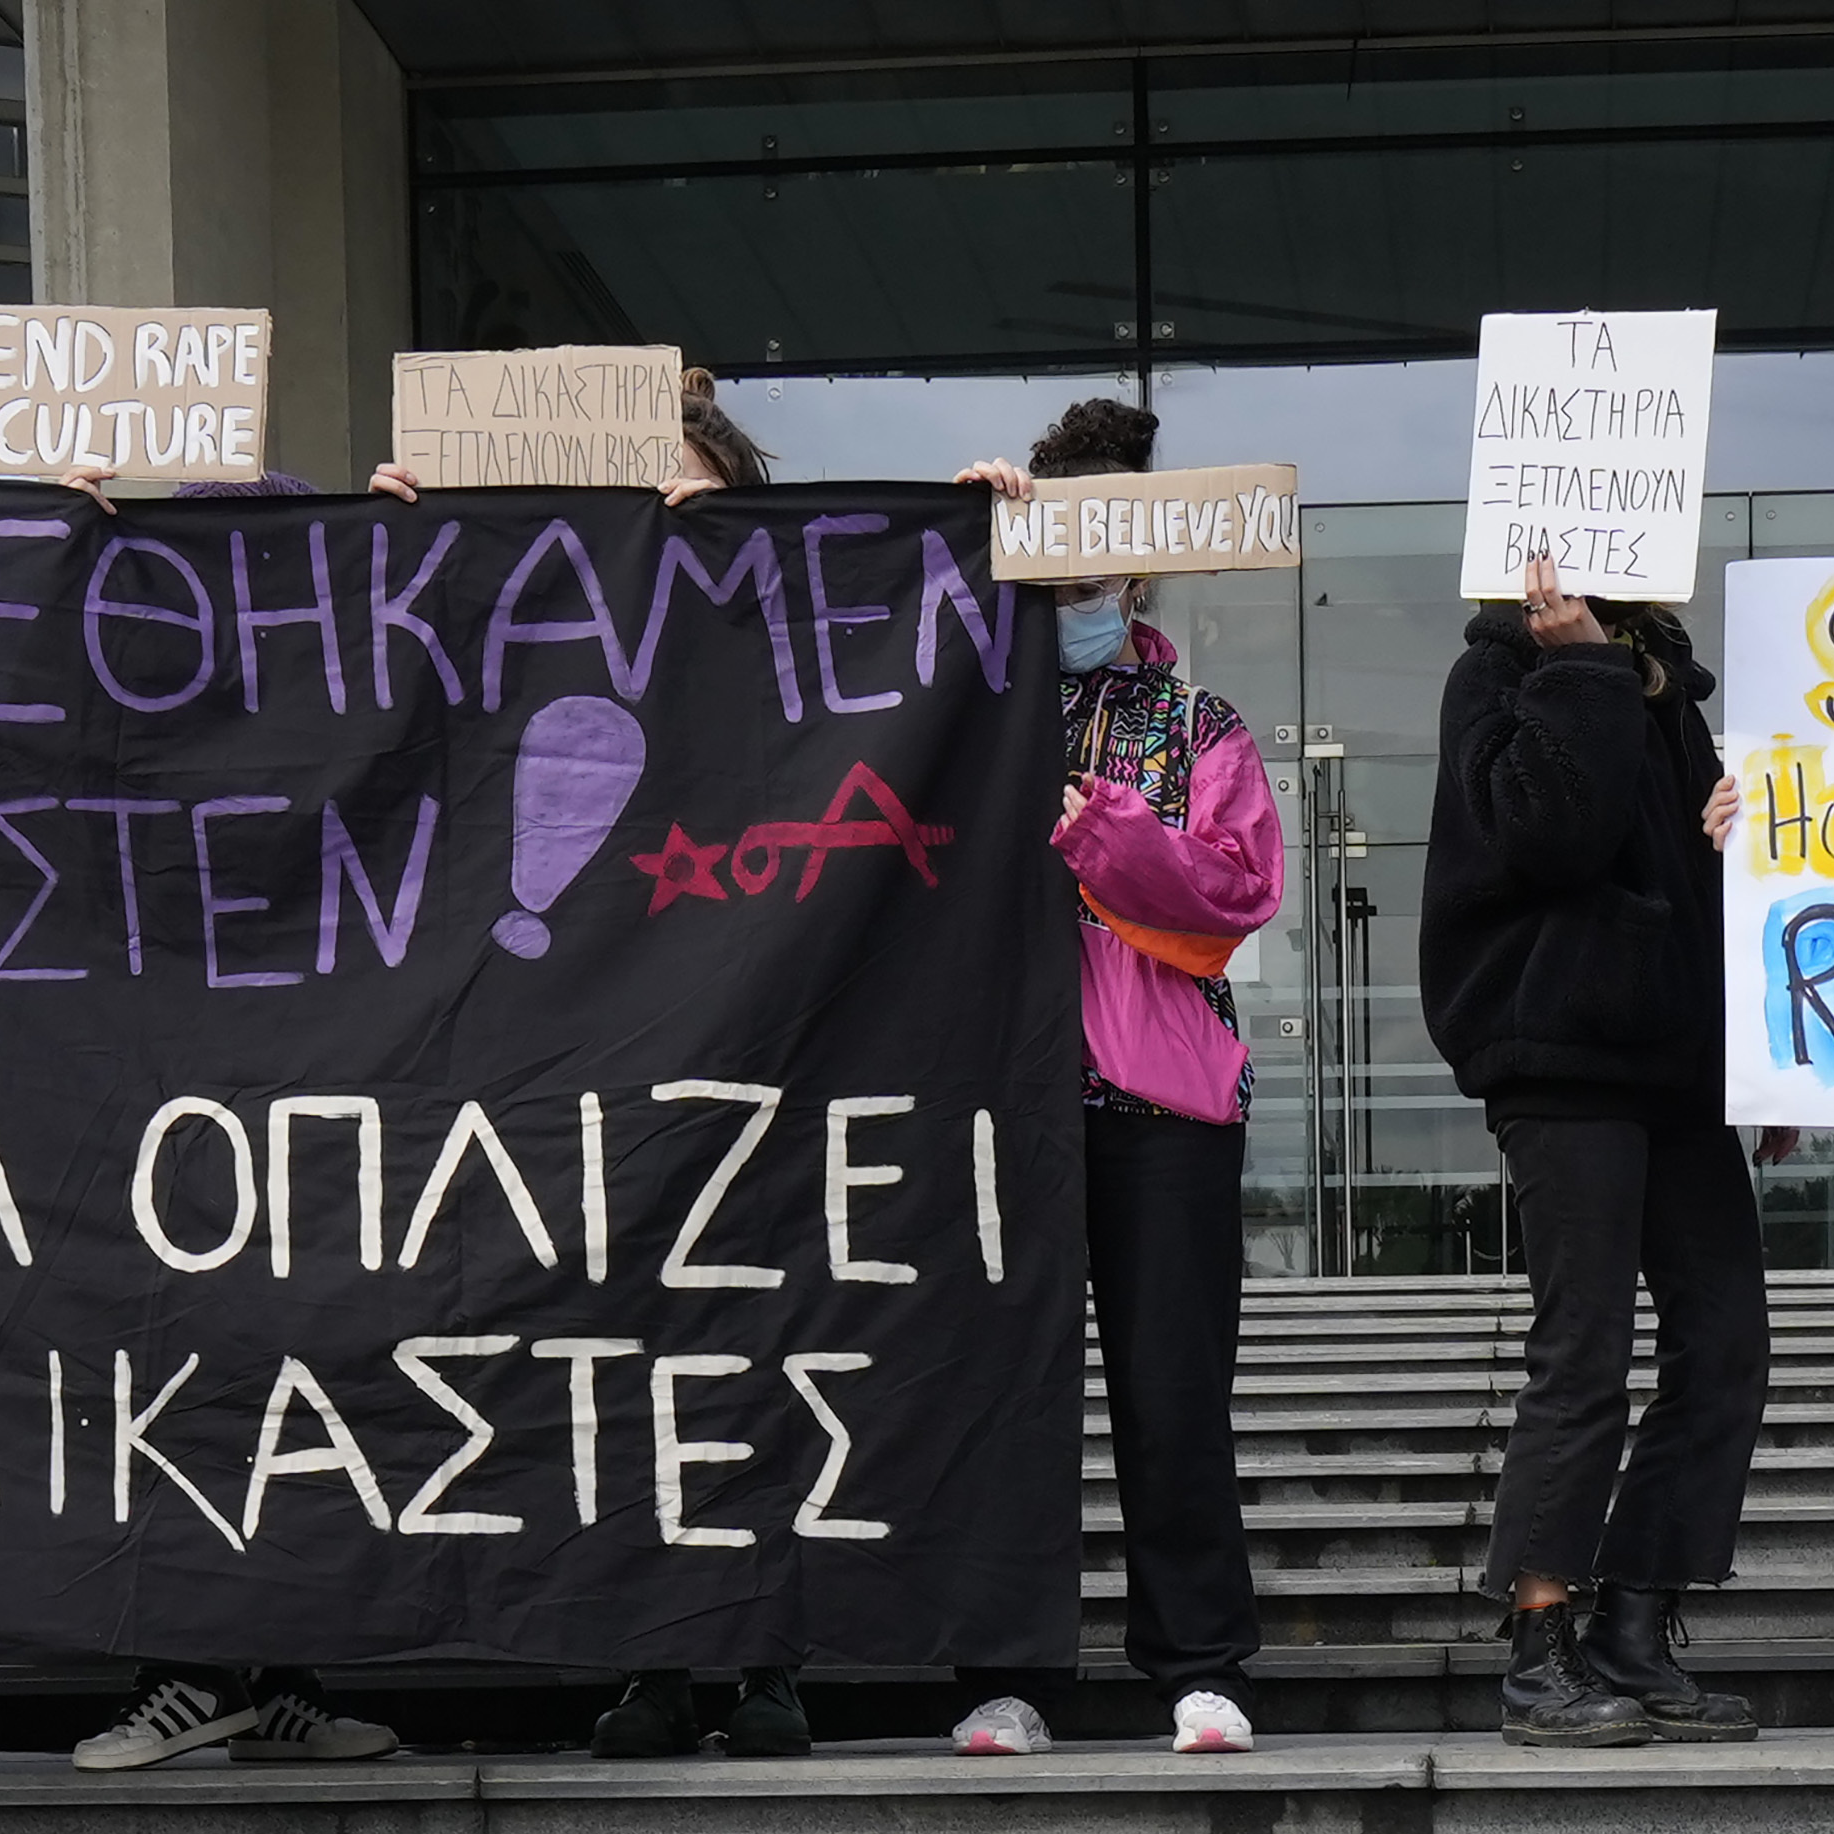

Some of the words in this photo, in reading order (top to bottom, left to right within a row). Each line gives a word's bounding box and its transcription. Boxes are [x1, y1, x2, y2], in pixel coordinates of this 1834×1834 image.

[134, 321, 259, 389] RAPE
[1557, 321, 1617, 372] ΤΑ
[402, 363, 474, 419] ΤΑ
[1478, 381, 1685, 442] ΔΙΚΑΣΤΗΡΙΑ
[1483, 463, 1685, 513] ΞΕΠΛΕΝΟΥΝ
[995, 499, 1070, 557] WE
[1079, 497, 1234, 557] BELIEVE
[1236, 484, 1298, 555] YOU
[130, 1079, 1004, 1289] ΟΠΛΙΖΕΙ
